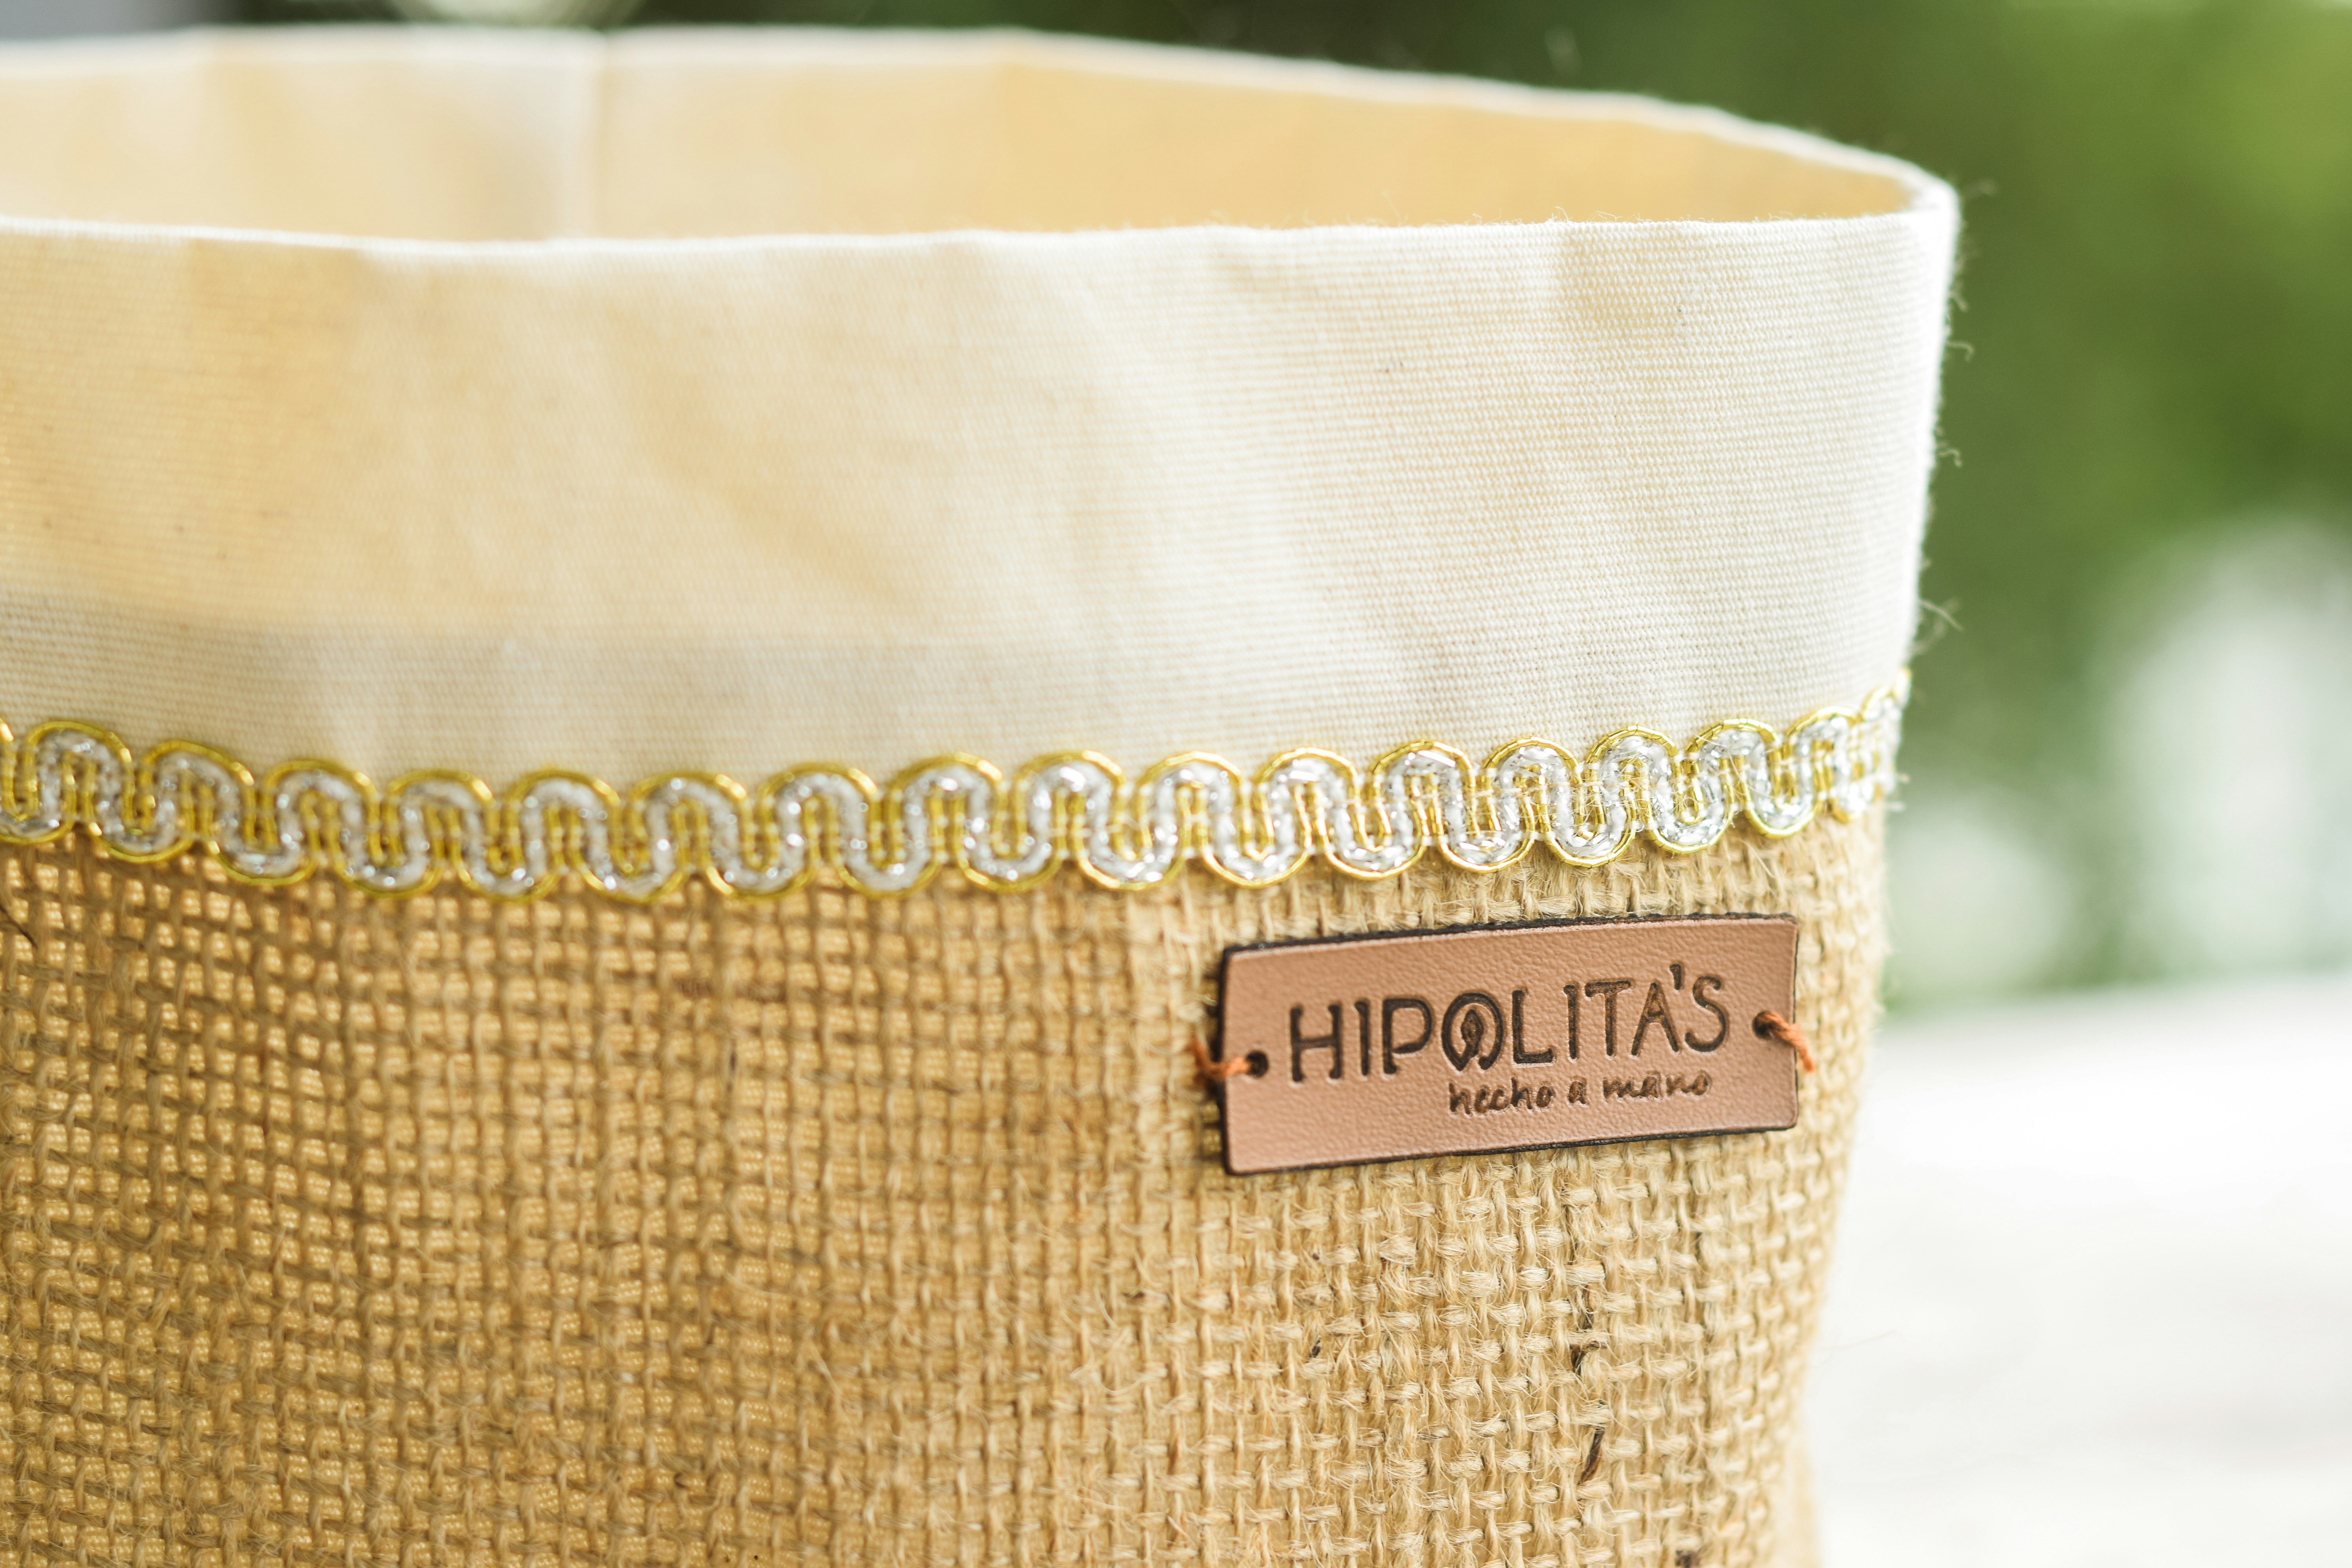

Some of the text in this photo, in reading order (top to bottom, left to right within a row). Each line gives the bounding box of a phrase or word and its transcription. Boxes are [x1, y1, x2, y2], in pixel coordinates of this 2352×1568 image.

[1289, 963, 1729, 1082] HIPOLITA'S
[1448, 1070, 1712, 1115] hecho a mano
